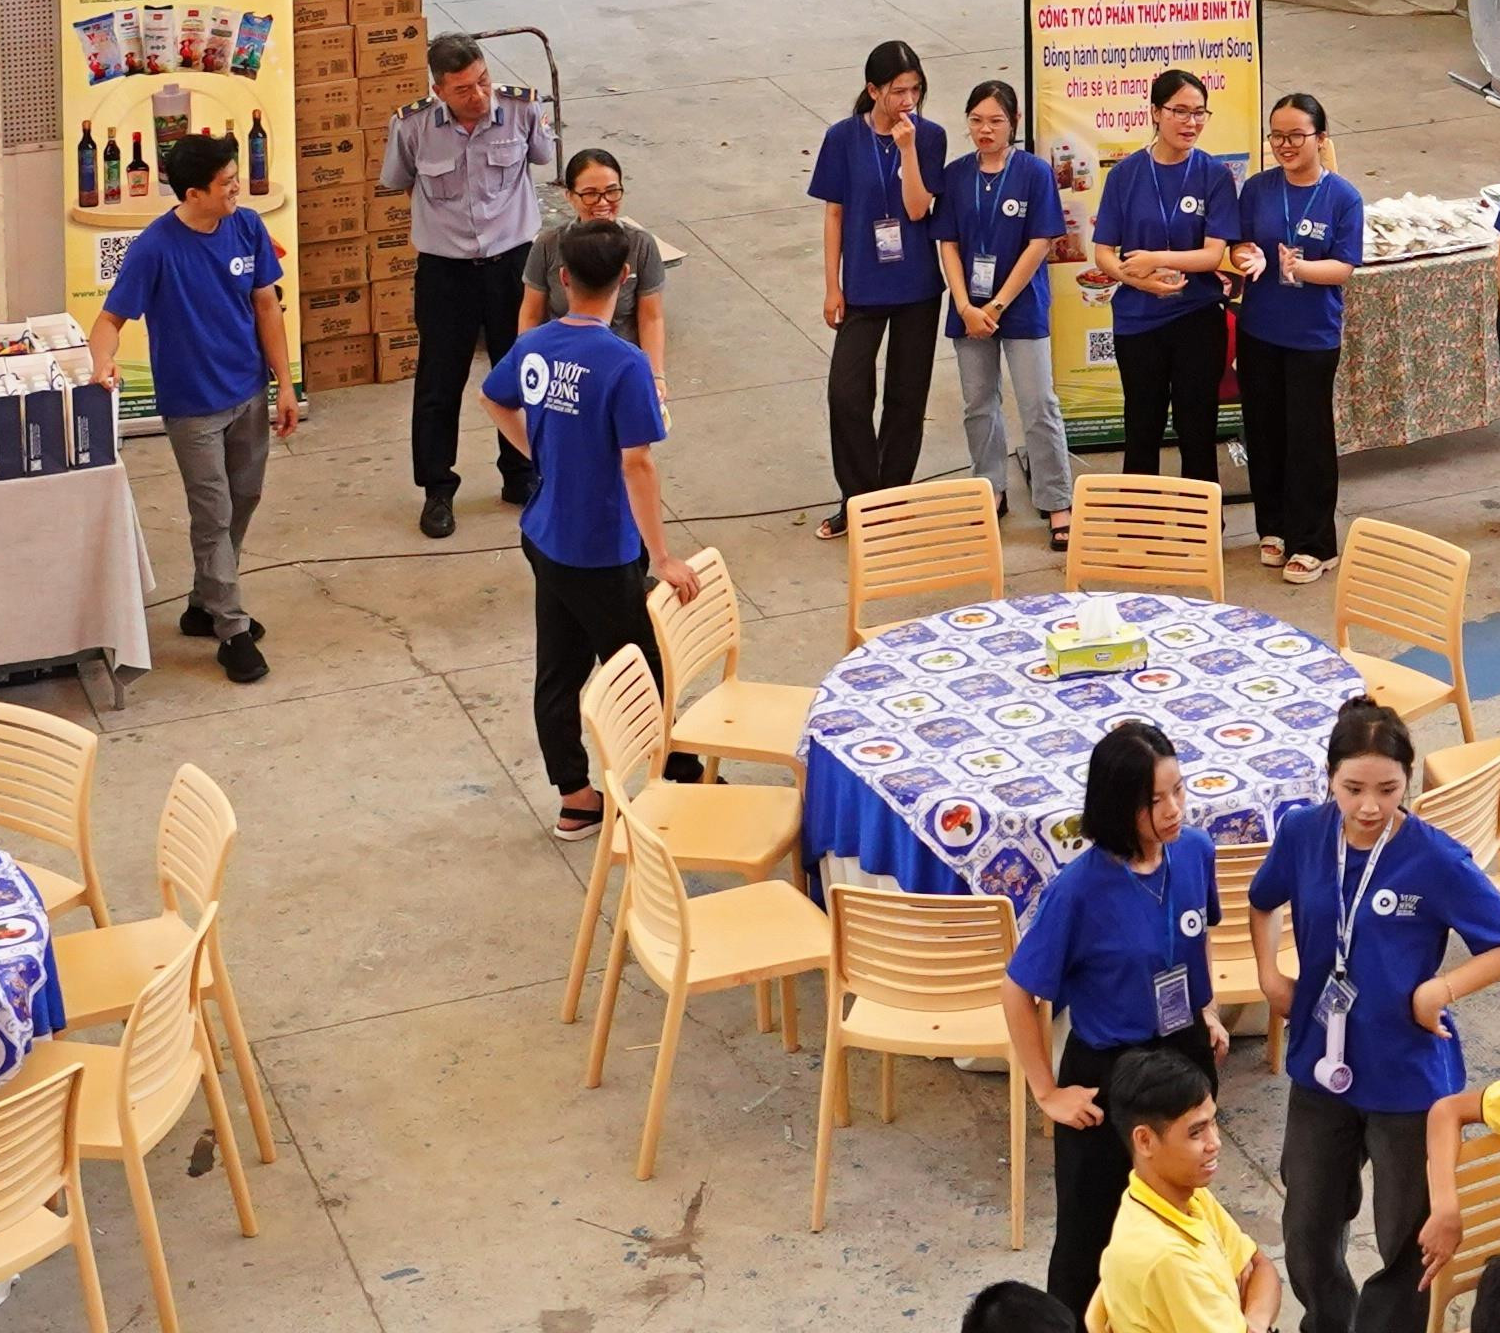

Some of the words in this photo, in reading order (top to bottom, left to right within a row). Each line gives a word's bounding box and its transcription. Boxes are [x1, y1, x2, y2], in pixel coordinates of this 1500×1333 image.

[1038, 4, 1068, 29] CÔNG
[1071, 8, 1085, 27] TY
[1138, 0, 1166, 29] THỰC
[1073, 42, 1098, 66] hành
[1101, 42, 1127, 69] cùng
[1129, 40, 1170, 67] chương
[1172, 39, 1196, 61] trình
[1199, 39, 1224, 65] Vượt
[1227, 35, 1254, 64] Sóng
[1067, 76, 1088, 99] chia
[1106, 76, 1118, 96] và
[1120, 77, 1149, 100] mang
[1096, 107, 1115, 129] cho
[1117, 104, 1150, 133] người
